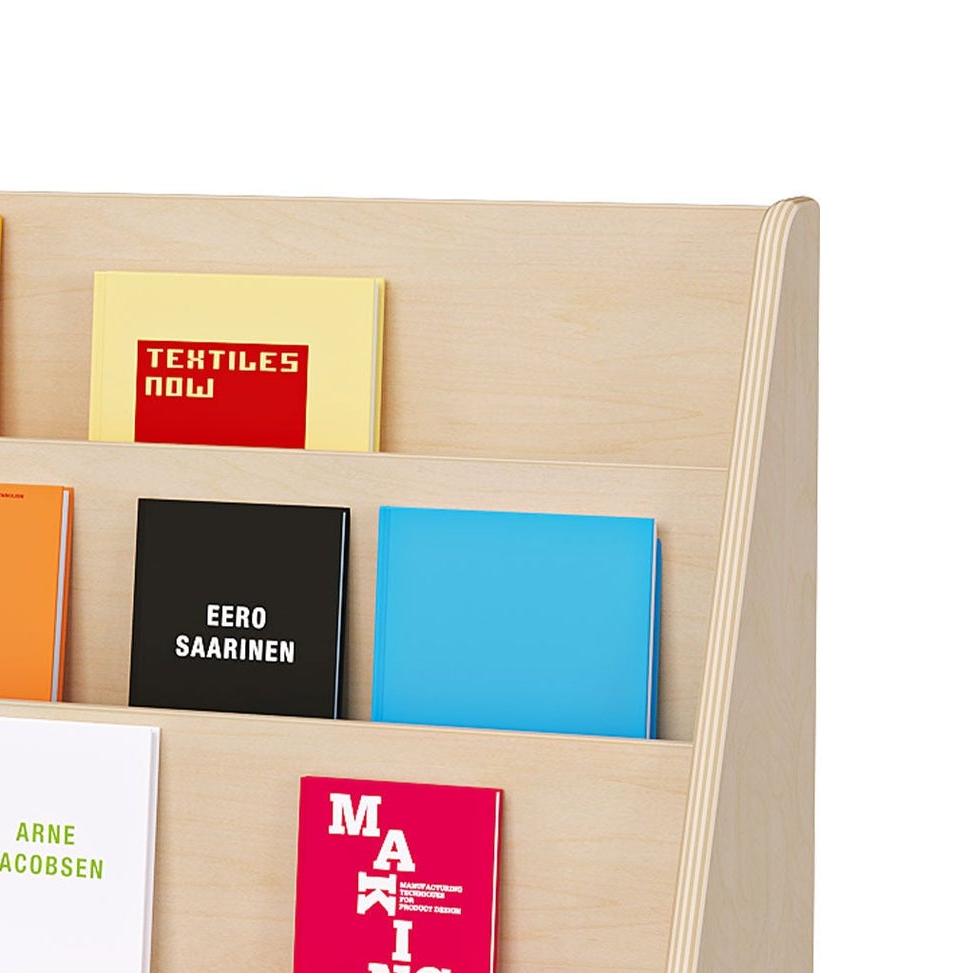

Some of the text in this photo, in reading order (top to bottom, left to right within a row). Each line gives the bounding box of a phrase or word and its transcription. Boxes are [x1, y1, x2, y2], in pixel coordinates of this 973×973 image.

[146, 347, 299, 373] TEXTILES
[206, 604, 267, 630] EERO
[175, 634, 295, 663] SAARINEN
[16, 822, 75, 845] ARNE
